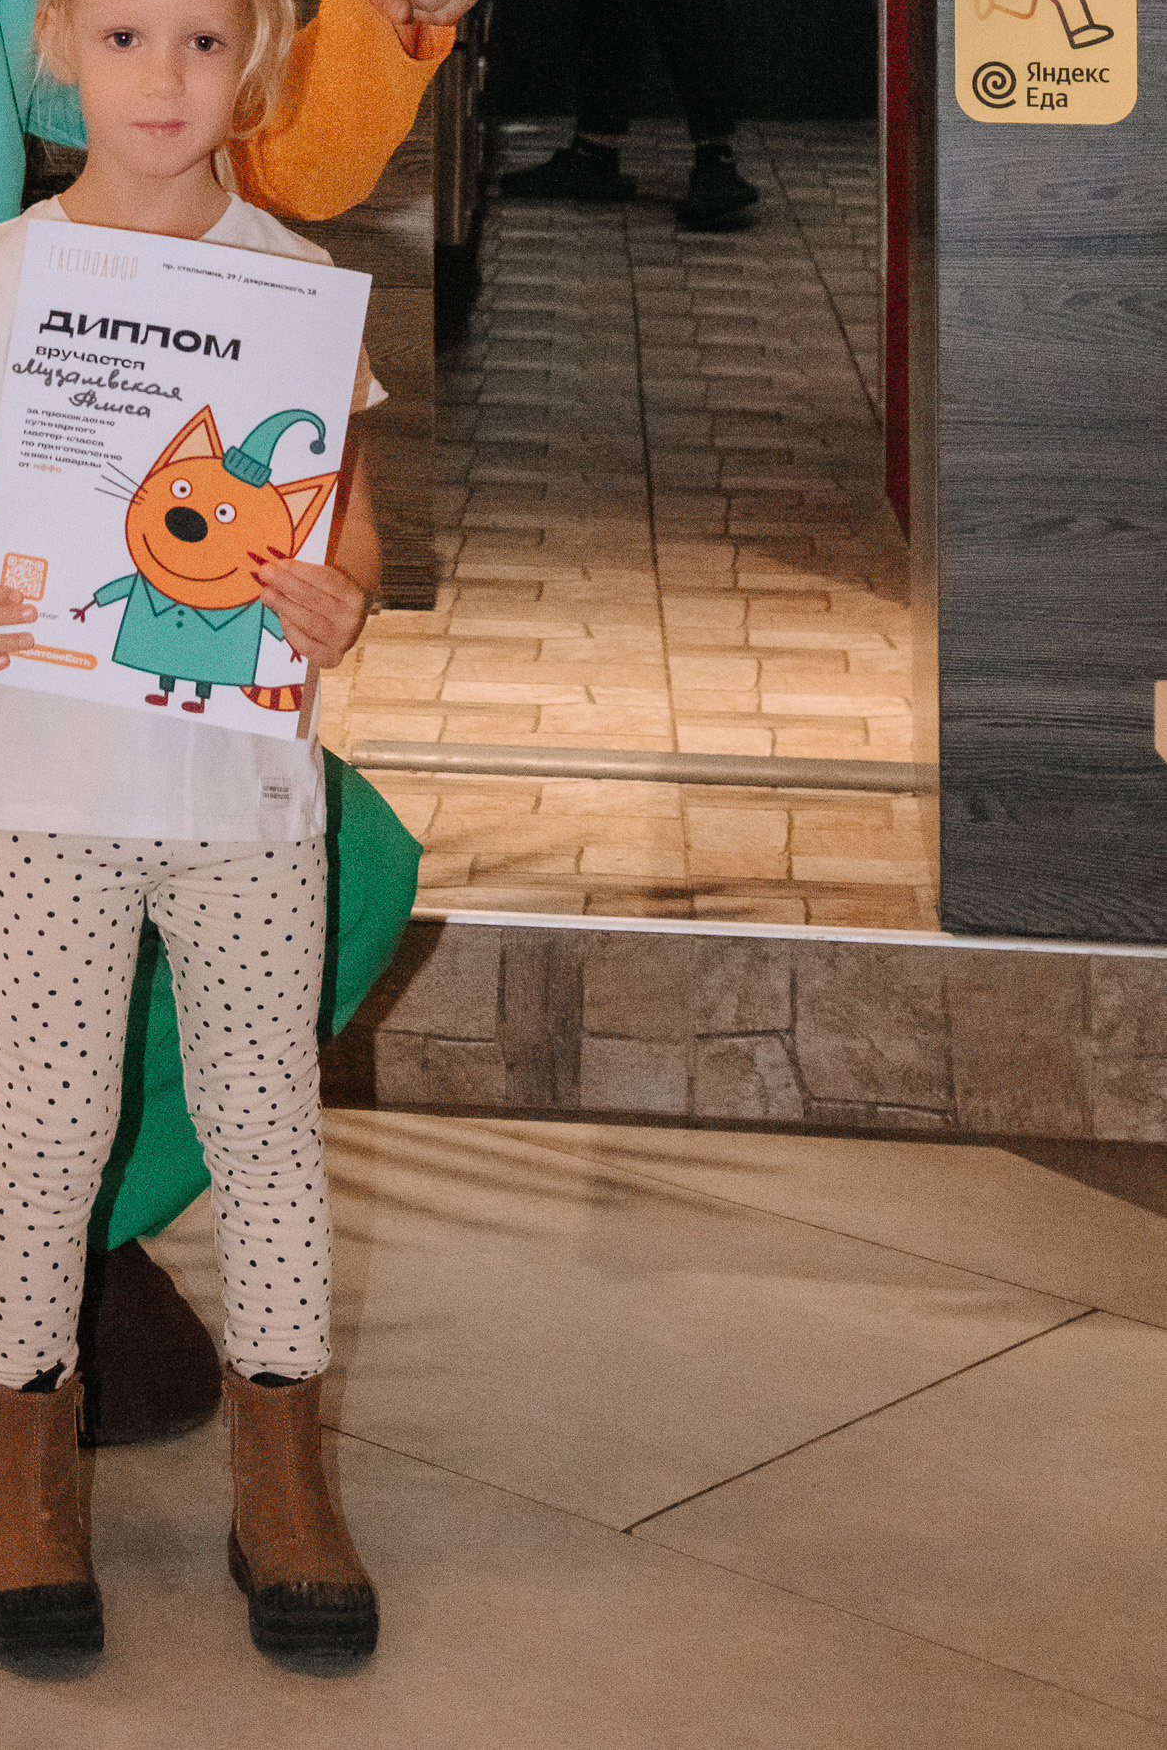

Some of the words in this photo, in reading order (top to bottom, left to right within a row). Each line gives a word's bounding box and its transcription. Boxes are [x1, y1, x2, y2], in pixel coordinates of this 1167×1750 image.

[1027, 61, 1110, 85] Яндекс
[1027, 87, 1068, 110] Еда
[39, 310, 242, 361] ДИПЛОМ
[36, 345, 145, 371] вручается
[67, 388, 151, 418] Алиса
